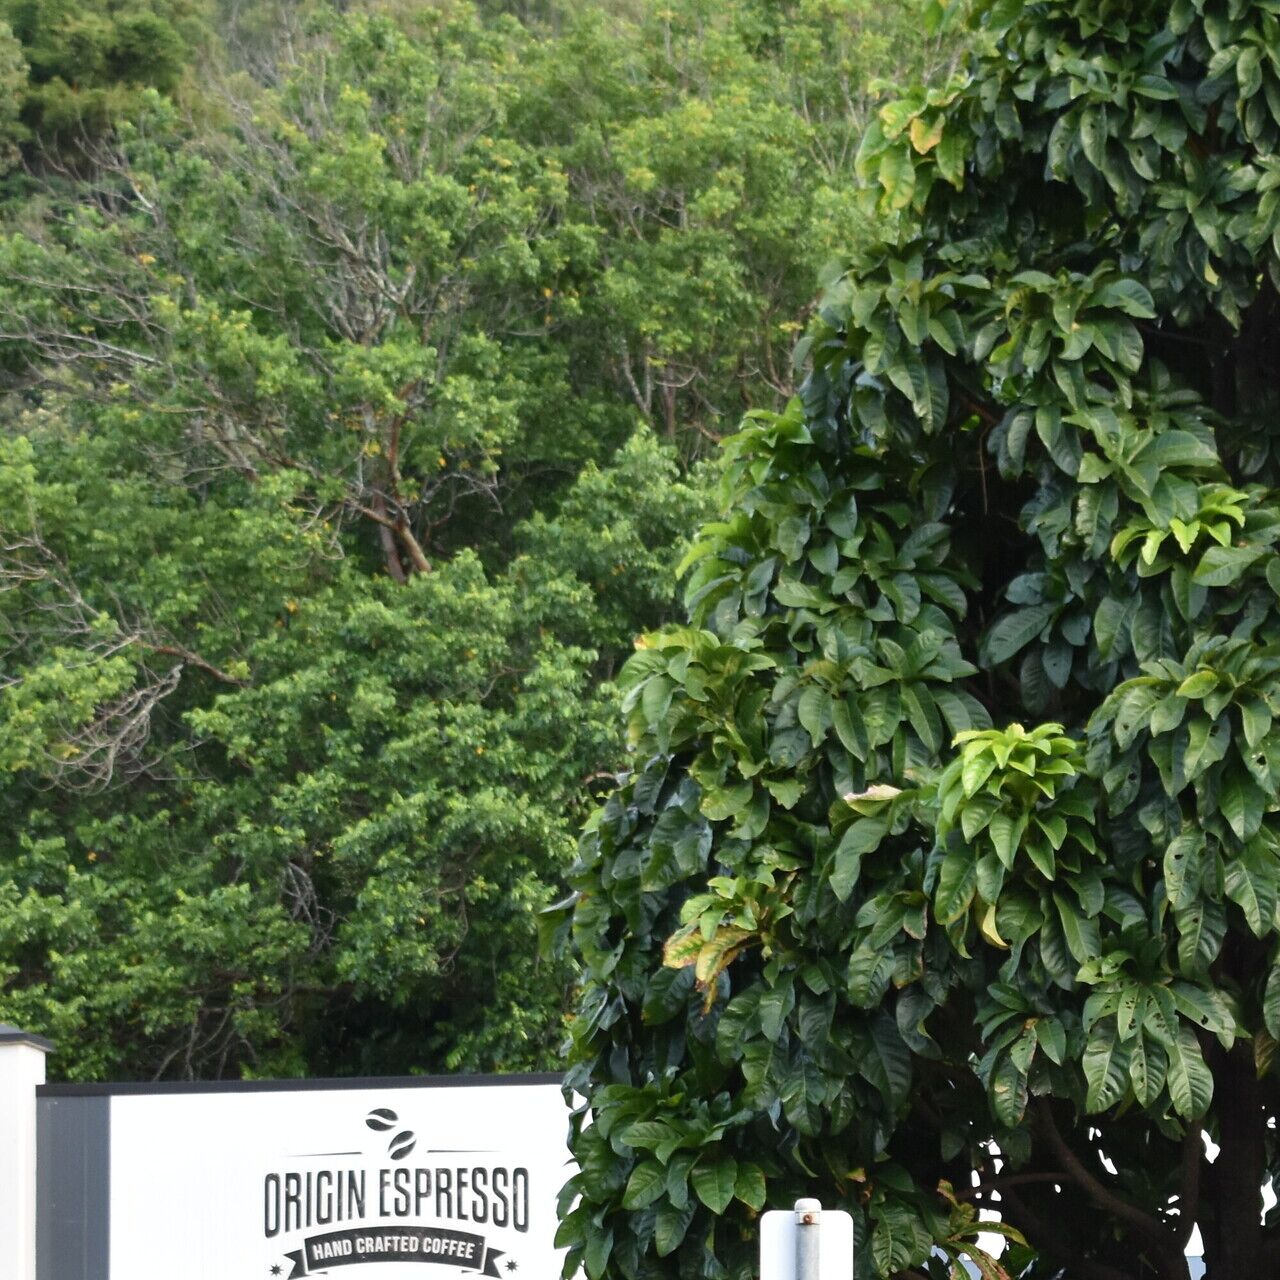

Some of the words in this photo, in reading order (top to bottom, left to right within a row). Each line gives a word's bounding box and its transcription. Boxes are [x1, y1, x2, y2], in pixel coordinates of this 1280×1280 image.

[264, 1169, 366, 1238] ORIGIN
[379, 1167, 529, 1233] ESPRESSO
[312, 1238, 352, 1261] HAND
[356, 1236, 419, 1254] CRAFTED
[423, 1236, 475, 1259] COFFEE
